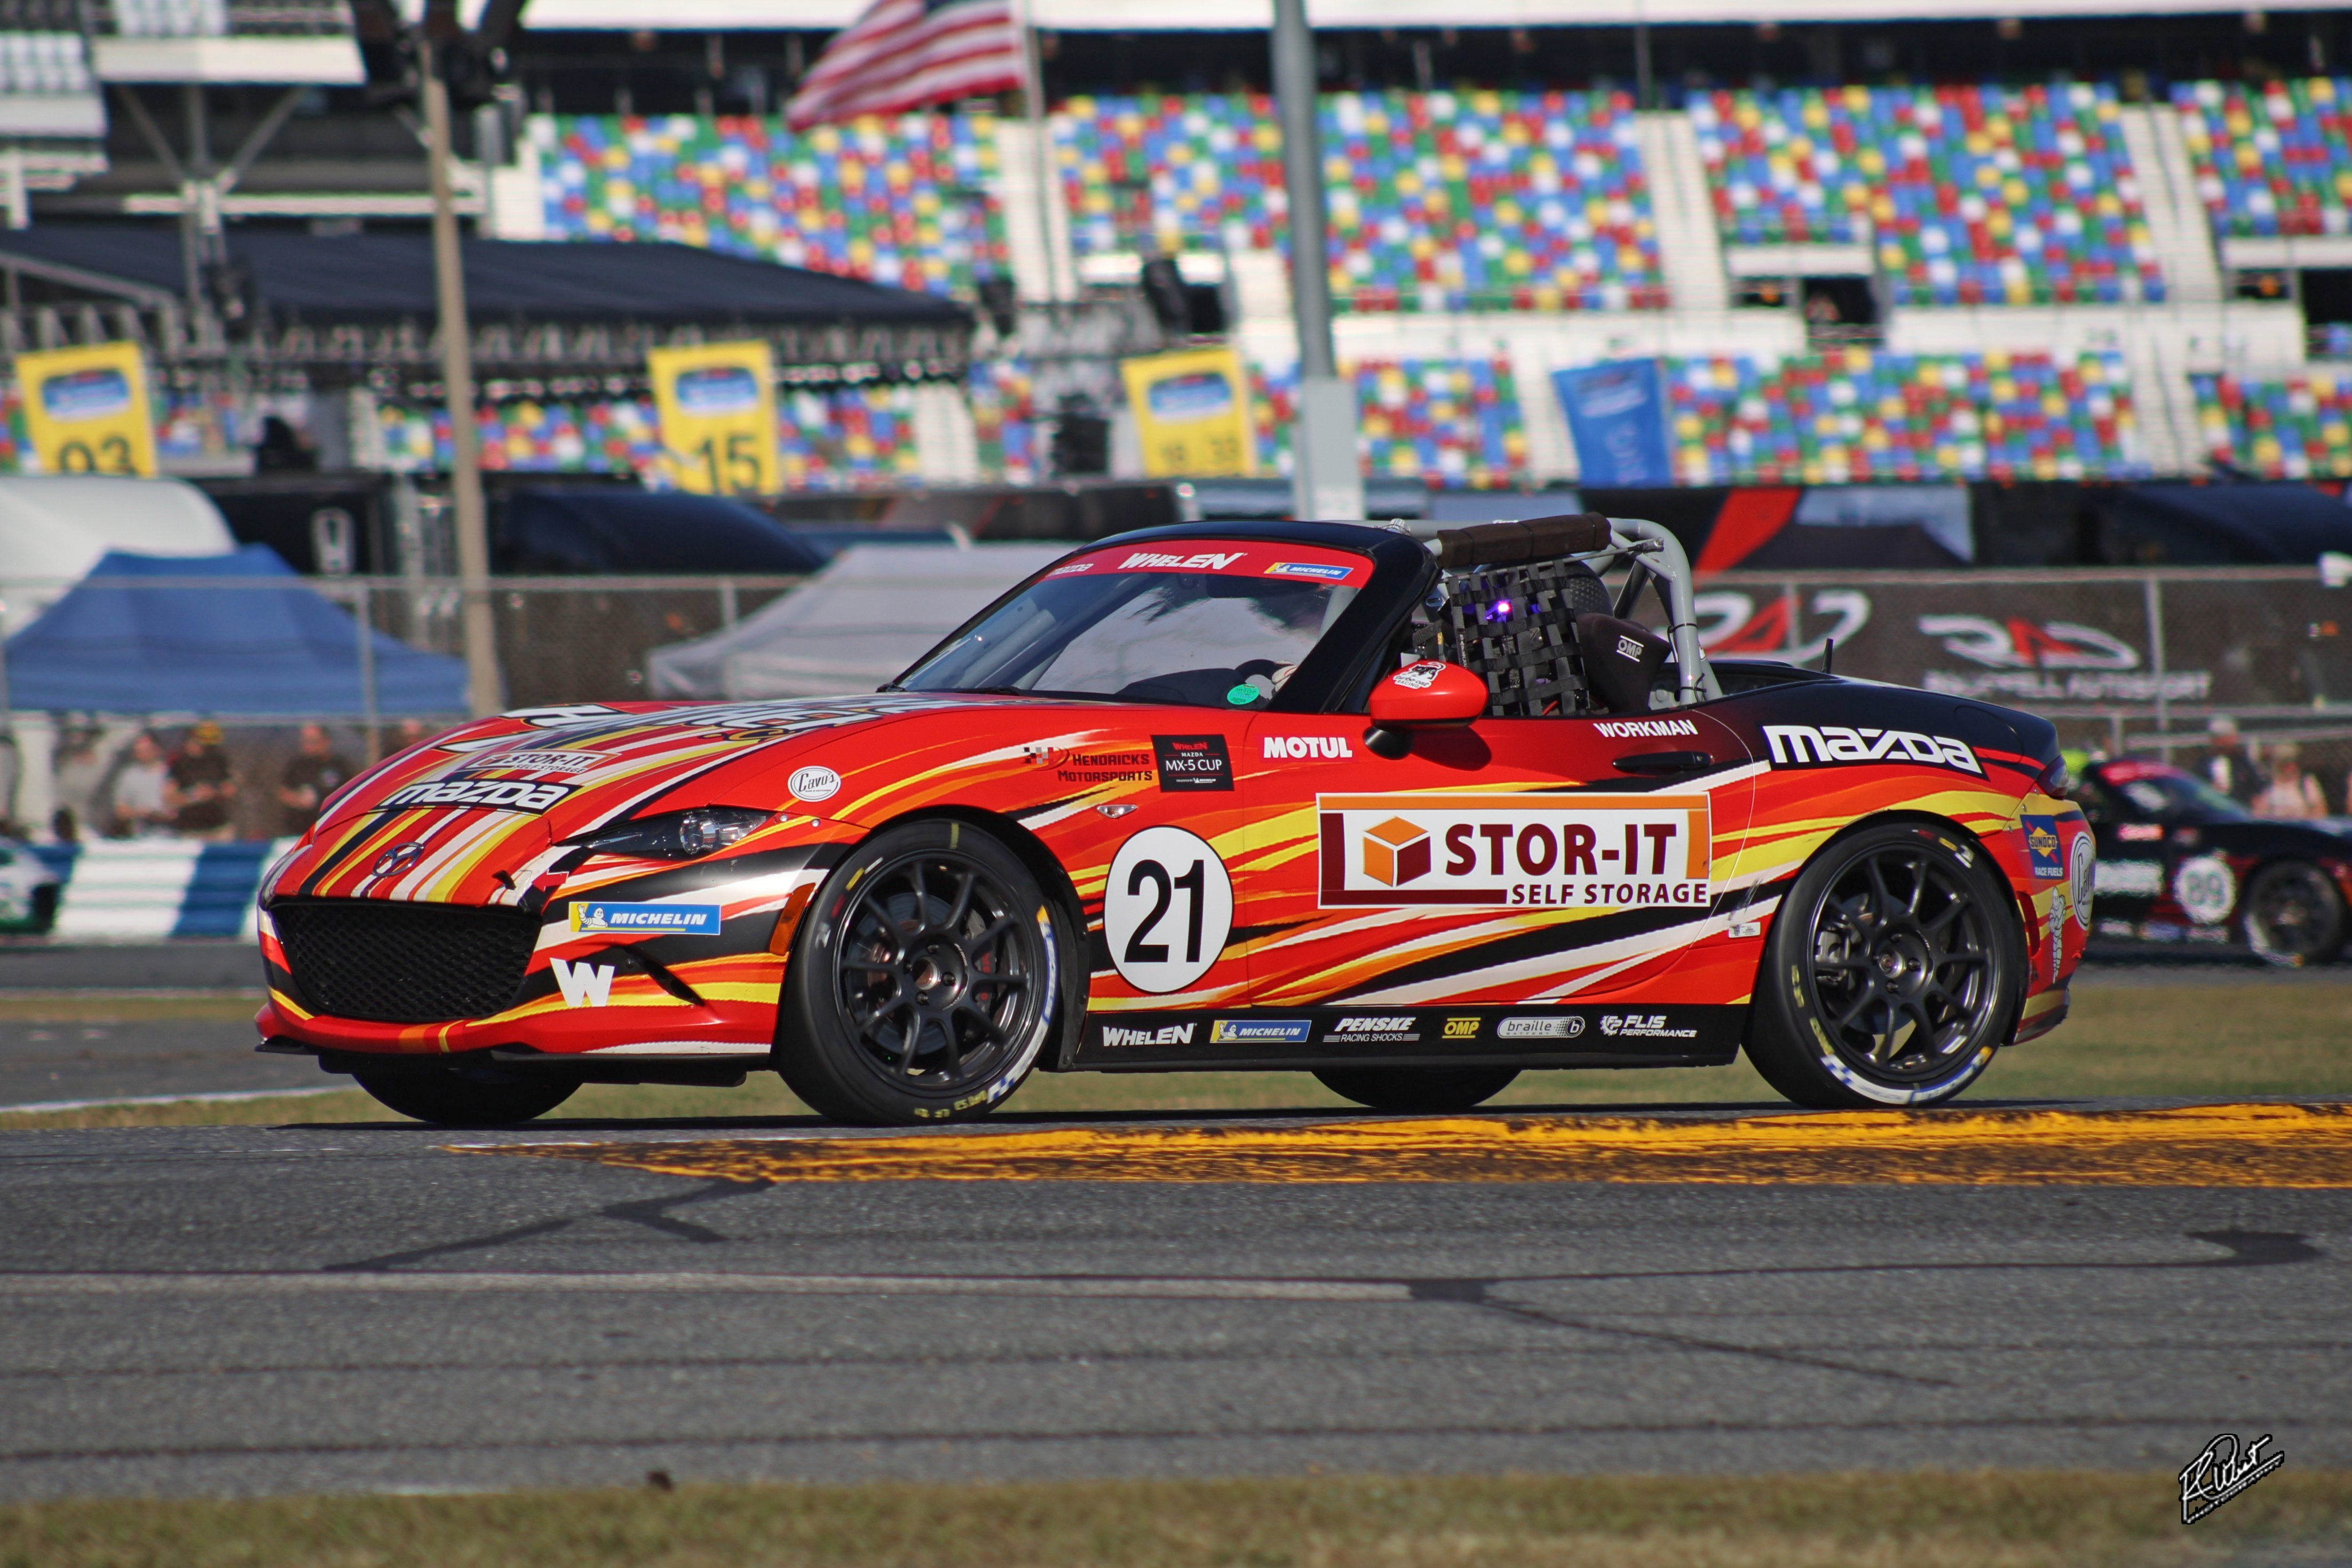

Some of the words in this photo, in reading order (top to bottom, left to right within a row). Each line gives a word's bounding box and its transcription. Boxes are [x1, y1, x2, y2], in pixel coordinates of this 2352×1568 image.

[1118, 552, 1246, 569] WHELEN
[1289, 565, 1343, 575] MICHELIN
[1618, 639, 1642, 658] OMP
[1397, 679, 1419, 688] RACING
[1593, 719, 1699, 738] WORKMAN
[1172, 742, 1208, 750] WHELEN
[1263, 737, 1353, 758] MOTUL
[506, 754, 596, 766] STOR-IT
[1072, 754, 1150, 766] HENDRICKS
[1166, 759, 1195, 771] MX-5
[1197, 759, 1222, 771] CUP
[537, 764, 588, 774] STORAGE
[1057, 770, 1153, 782] MOTORSPORTS
[798, 773, 836, 792] Cavo's
[2030, 836, 2056, 848] SUNOCO
[1445, 823, 1677, 876] STOR-IT
[2047, 867, 2063, 877] FUELS
[1511, 883, 1574, 905] SELF
[1583, 883, 1707, 905] STORAGE
[1123, 859, 1205, 963] 21
[610, 913, 707, 925] MICHELIN
[550, 957, 615, 1007] W
[1334, 1017, 1417, 1032] PENSKE
[1507, 1020, 1552, 1032] braille
[1623, 1015, 1667, 1028] FLIS
[1239, 1027, 1301, 1036] MICHELIN
[1444, 1021, 1479, 1035] OMP
[1619, 1028, 1698, 1038] PERFORMANCE
[1102, 1023, 1194, 1046] WHELEN
[1340, 1034, 1369, 1042] RACING
[1371, 1033, 1403, 1042] SHOCKS
